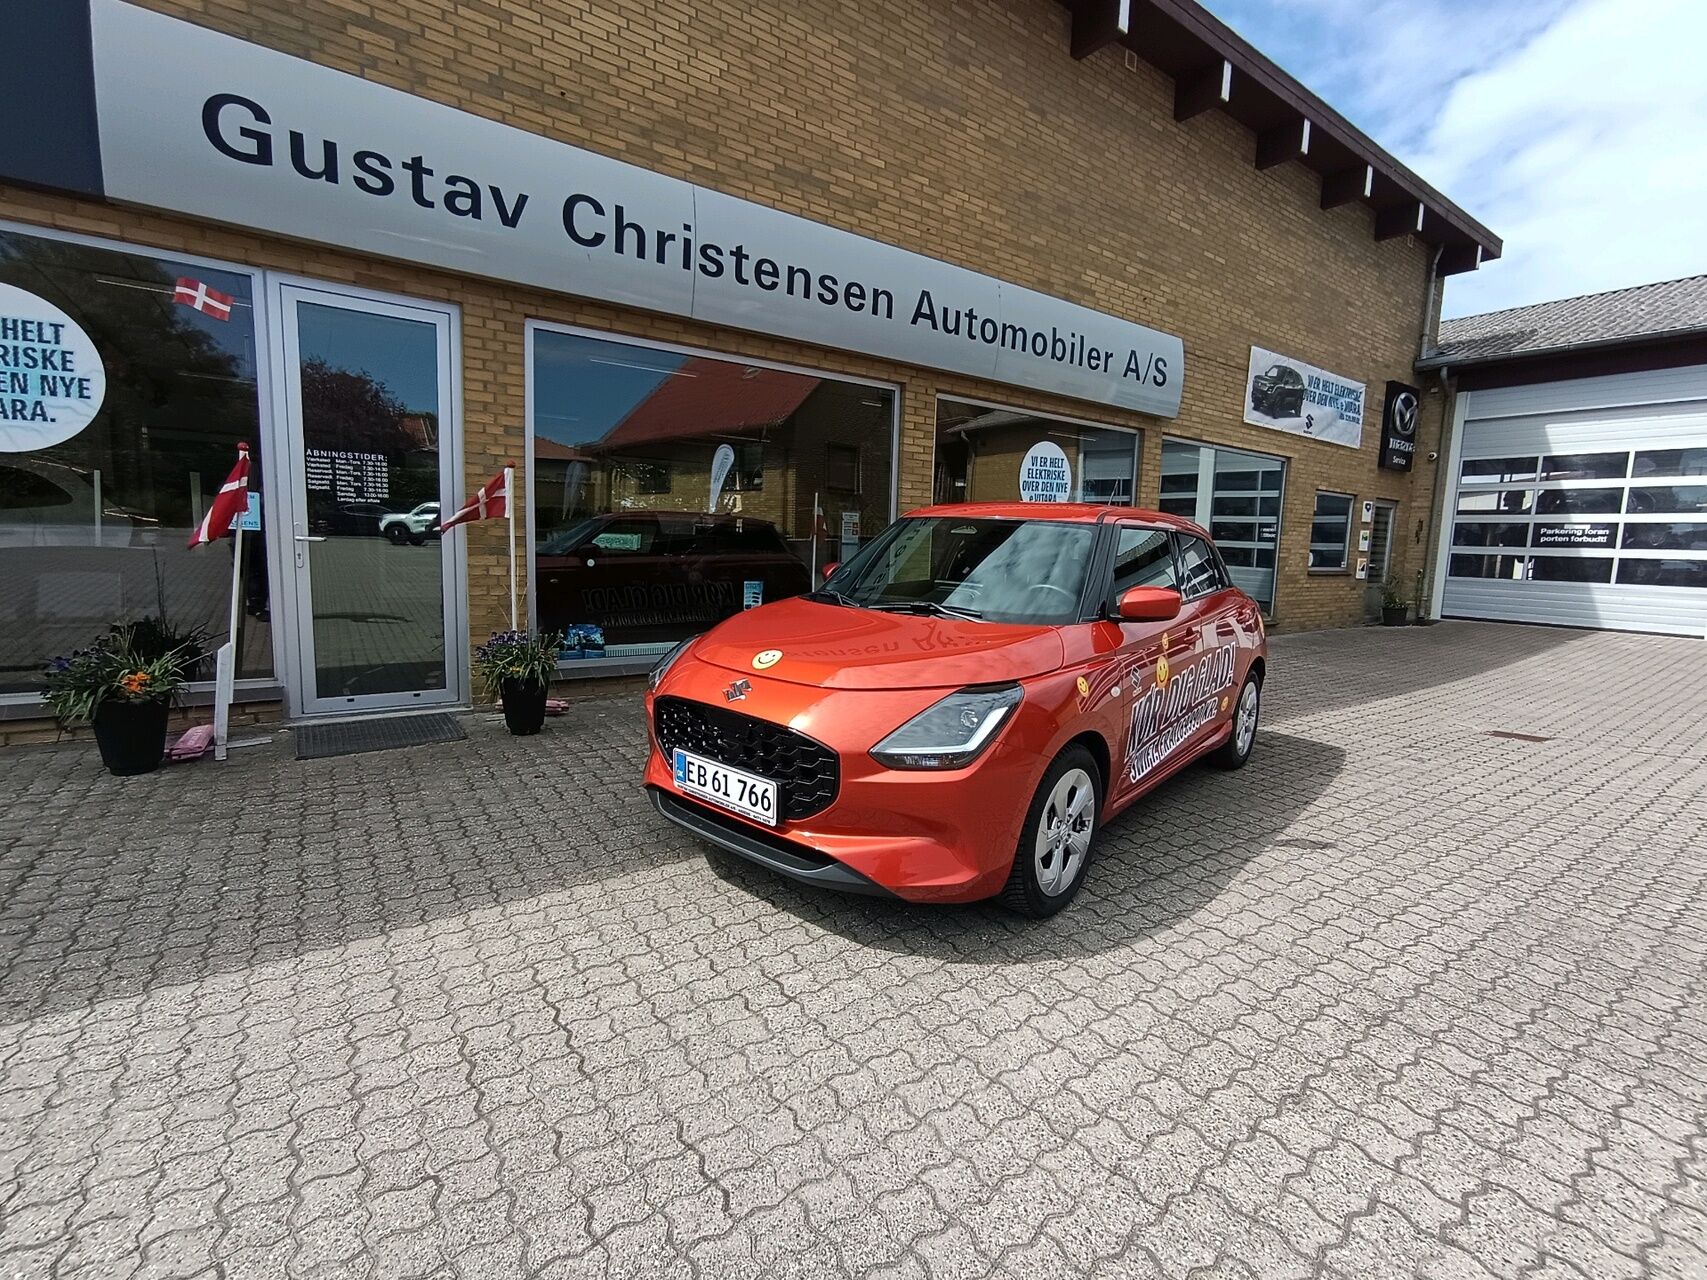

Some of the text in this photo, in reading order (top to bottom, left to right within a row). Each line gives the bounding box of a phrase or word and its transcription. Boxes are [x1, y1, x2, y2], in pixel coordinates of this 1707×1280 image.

[202, 93, 1168, 388] Gustav Christensen Automobiler A/S
[1, 317, 64, 345] HELT
[40, 374, 91, 399] NYE
[1027, 468, 1065, 481] ELEKTRISKE
[1031, 456, 1064, 469] VI ER HELT
[1022, 480, 1068, 493] OVER DEN NYE
[1540, 527, 1609, 536] Parkering foran
[1160, 664, 1195, 730] DIG
[1192, 641, 1236, 706] GLAD!
[687, 760, 771, 812] EB 61 766
